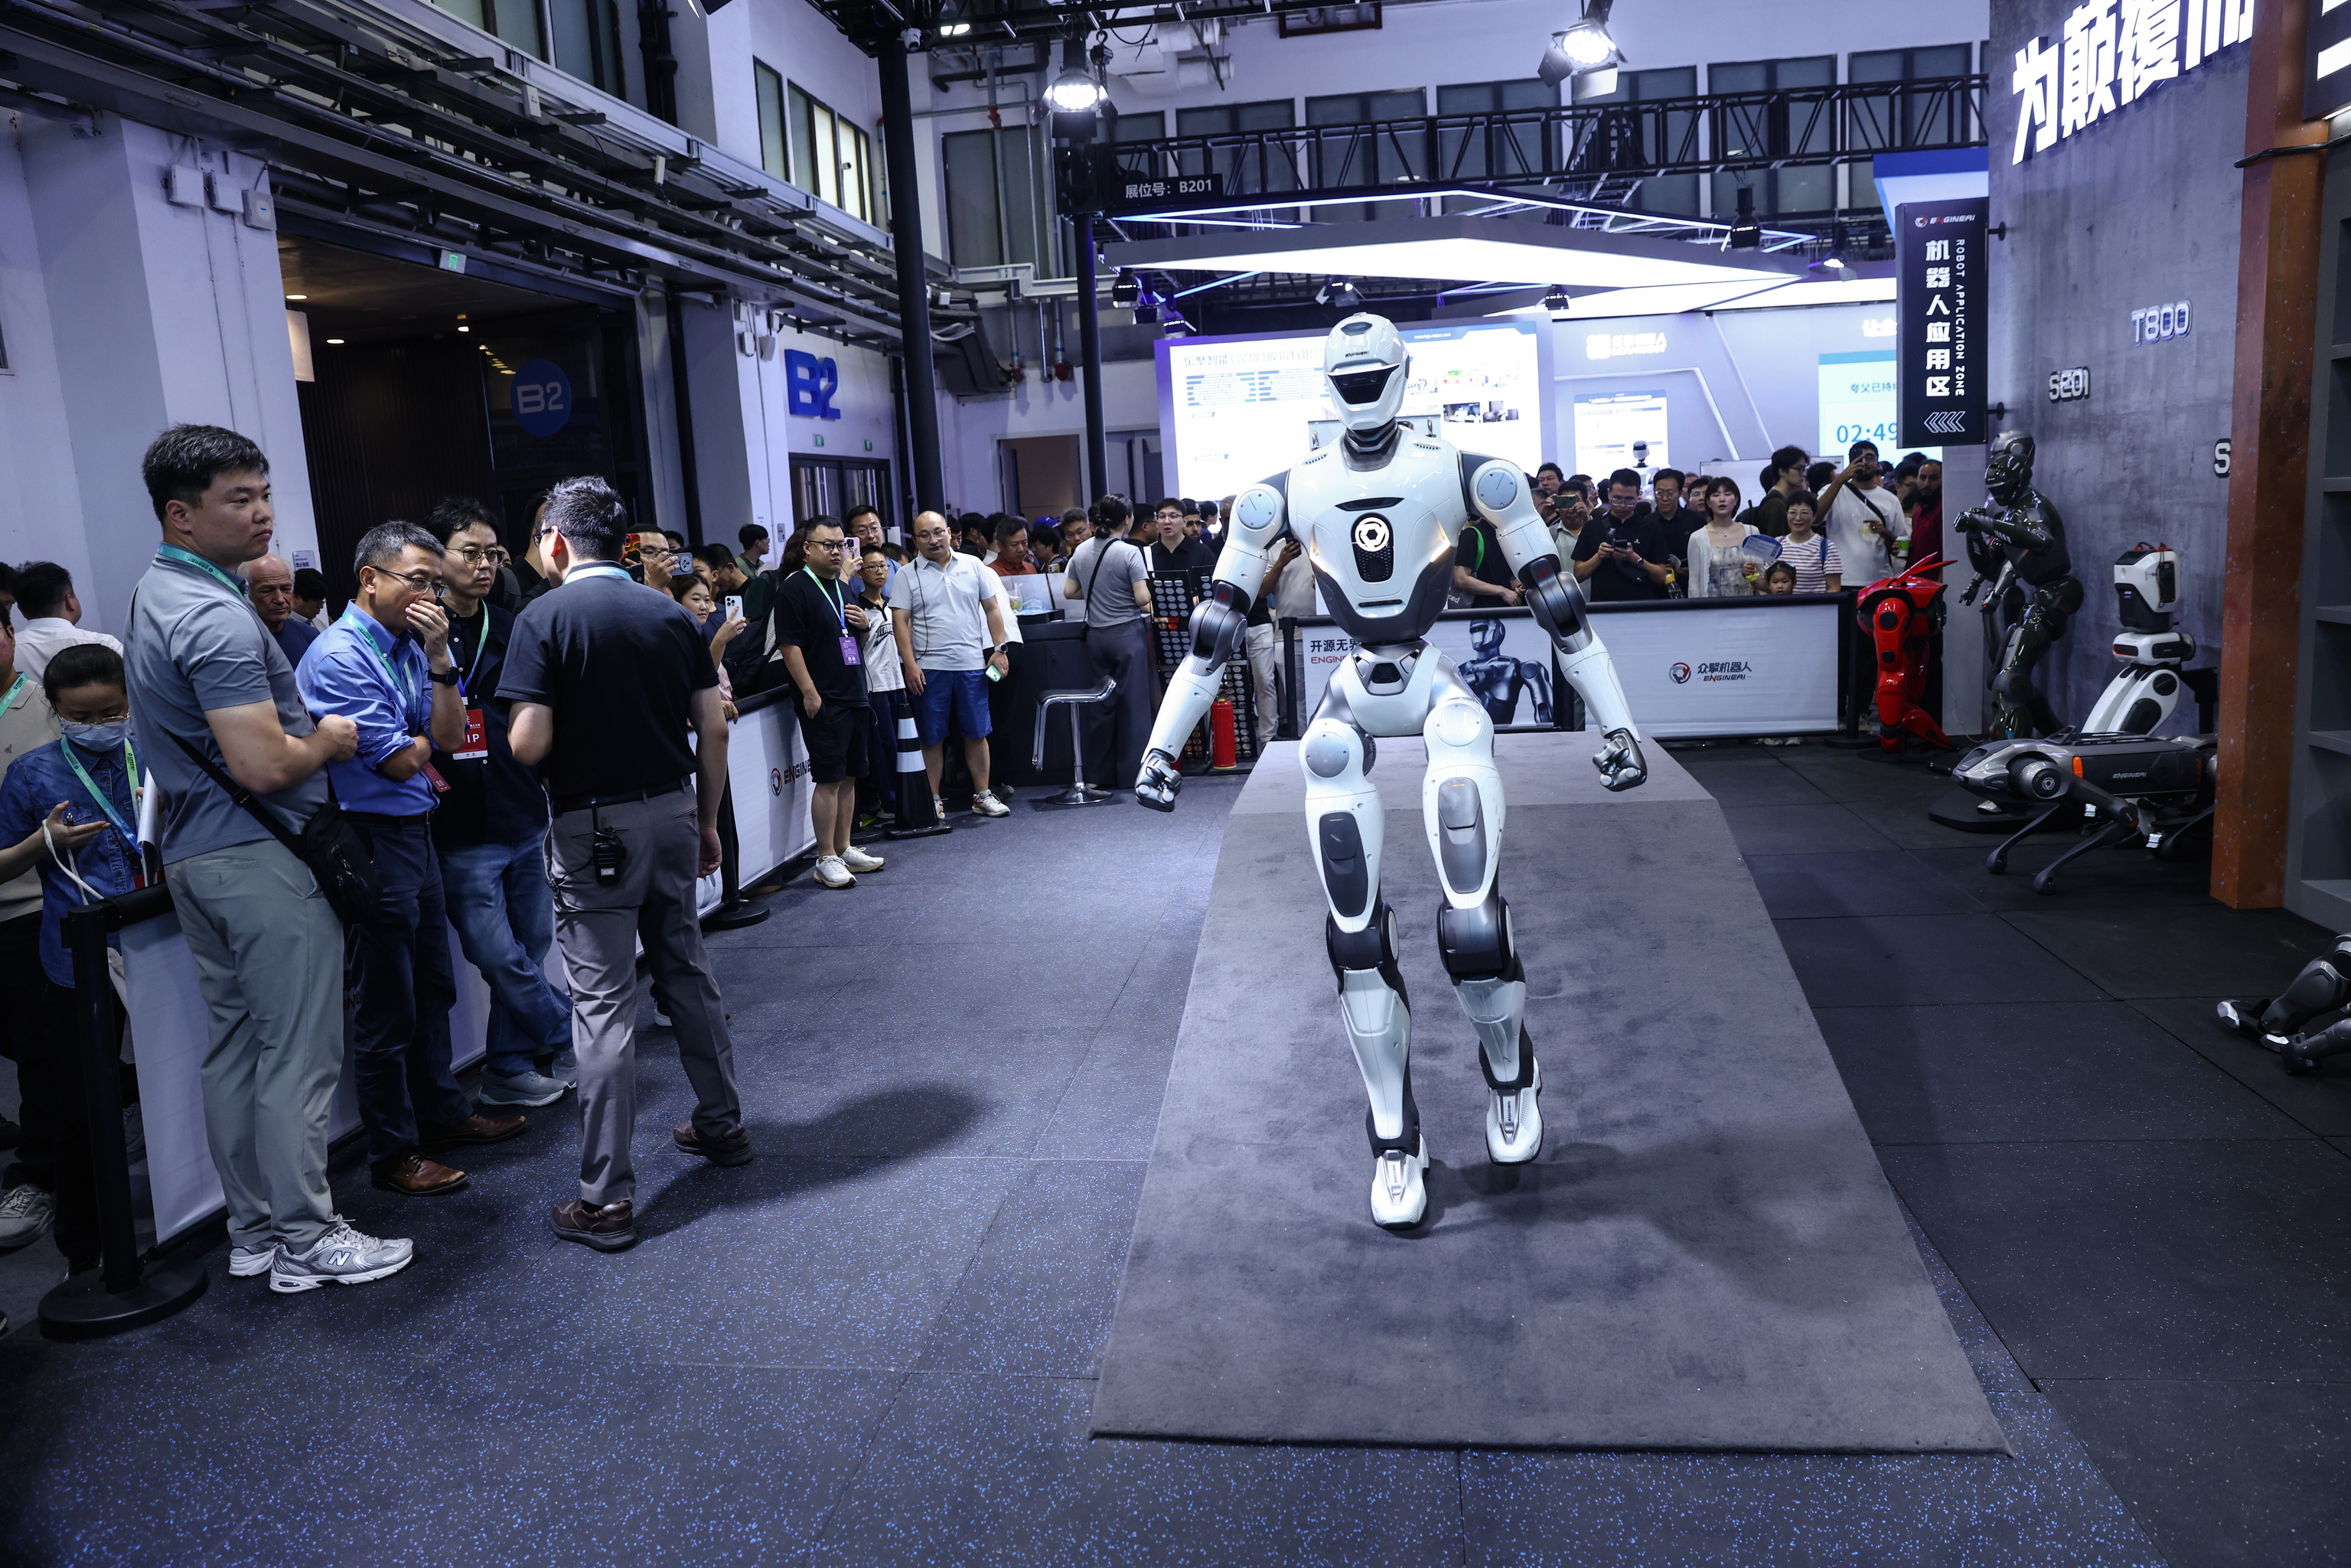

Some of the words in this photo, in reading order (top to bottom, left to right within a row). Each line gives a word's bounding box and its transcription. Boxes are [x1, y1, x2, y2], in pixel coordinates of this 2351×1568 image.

[1179, 178, 1212, 194] B201
[1955, 239, 1965, 277] ROBOT
[1925, 239, 1951, 396] 机器人应用区
[1955, 284, 1965, 360] APPLICATION
[2131, 301, 2191, 346] T800
[517, 381, 564, 413] B2
[784, 349, 841, 419] B2
[1955, 365, 1965, 396] ZONE
[467, 733, 480, 743] IP
